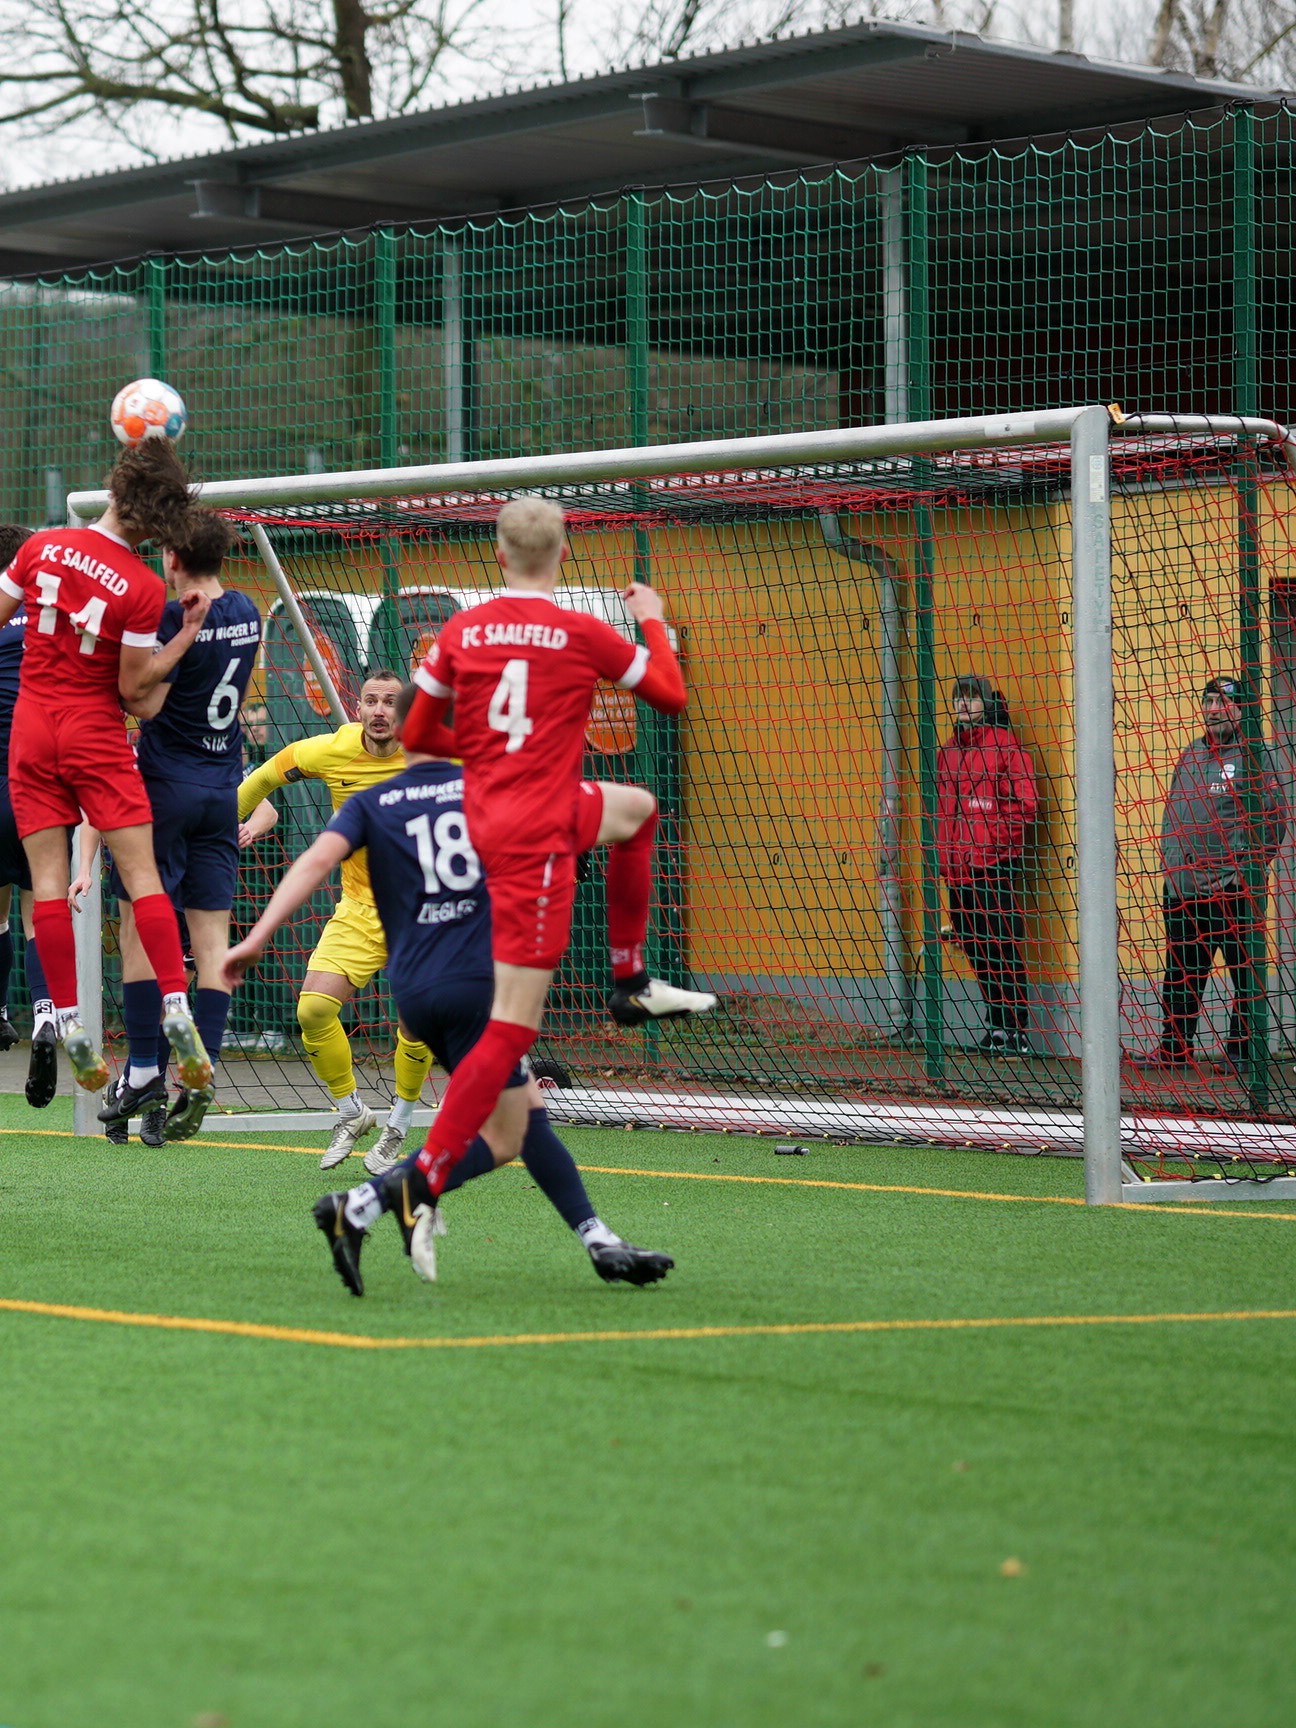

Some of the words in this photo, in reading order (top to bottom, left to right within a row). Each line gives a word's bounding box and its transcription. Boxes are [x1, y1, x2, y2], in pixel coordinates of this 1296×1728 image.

[40, 544, 62, 562] FC
[61, 547, 129, 596] SAALFELD
[36, 570, 108, 656] 14
[195, 627, 214, 642] FSV
[462, 624, 482, 649] FC
[484, 623, 568, 650] SAALFELD
[207, 658, 241, 730] 6
[488, 659, 533, 753] 4
[405, 811, 482, 894] 18
